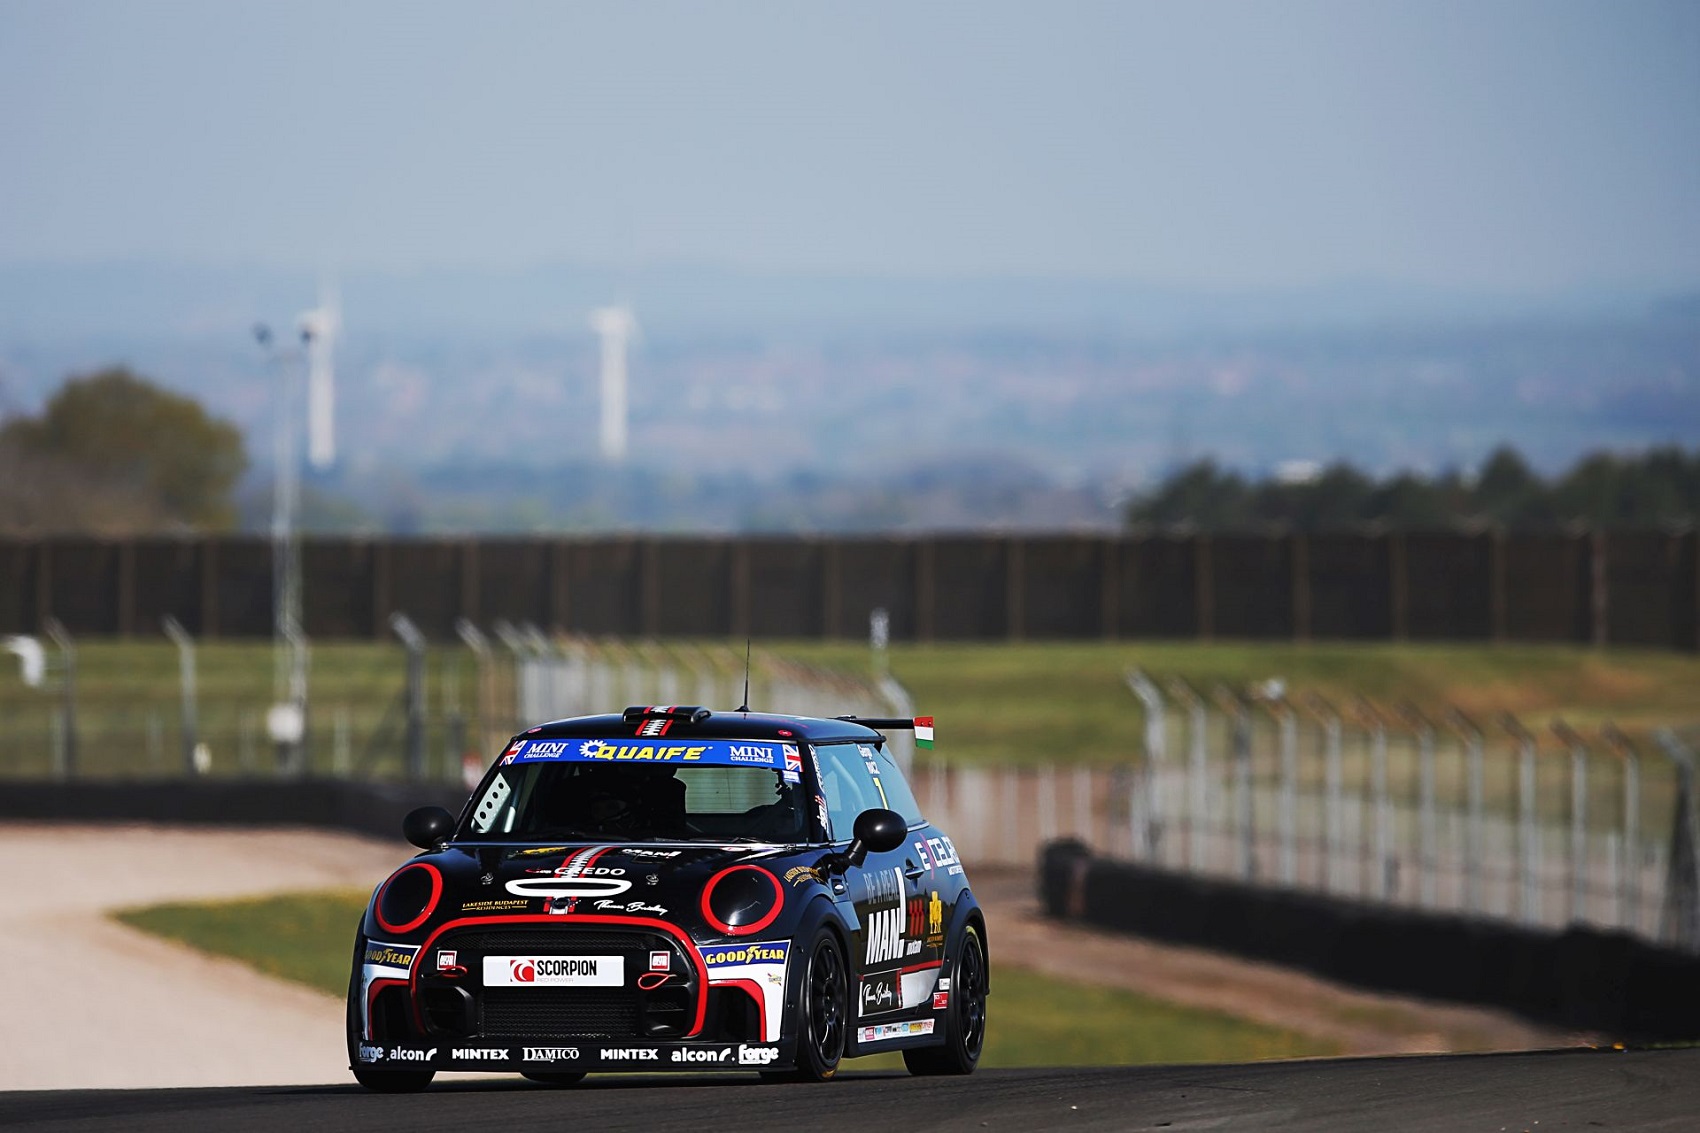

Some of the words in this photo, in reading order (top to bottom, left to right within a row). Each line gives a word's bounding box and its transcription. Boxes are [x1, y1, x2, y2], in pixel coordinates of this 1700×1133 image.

[527, 743, 569, 754] MINI
[596, 745, 706, 761] QUAIFE
[729, 746, 773, 758] MINI
[730, 756, 775, 764] CHALLENGE
[865, 866, 906, 965] MAN!
[705, 946, 785, 965] GOODYEAR
[536, 960, 597, 976] SCORPION
[389, 1046, 425, 1061] alcon
[452, 1049, 510, 1060] MINTEX
[600, 1049, 659, 1060] MINTEX
[671, 1047, 718, 1062] alcon
[738, 1044, 780, 1065] forge
